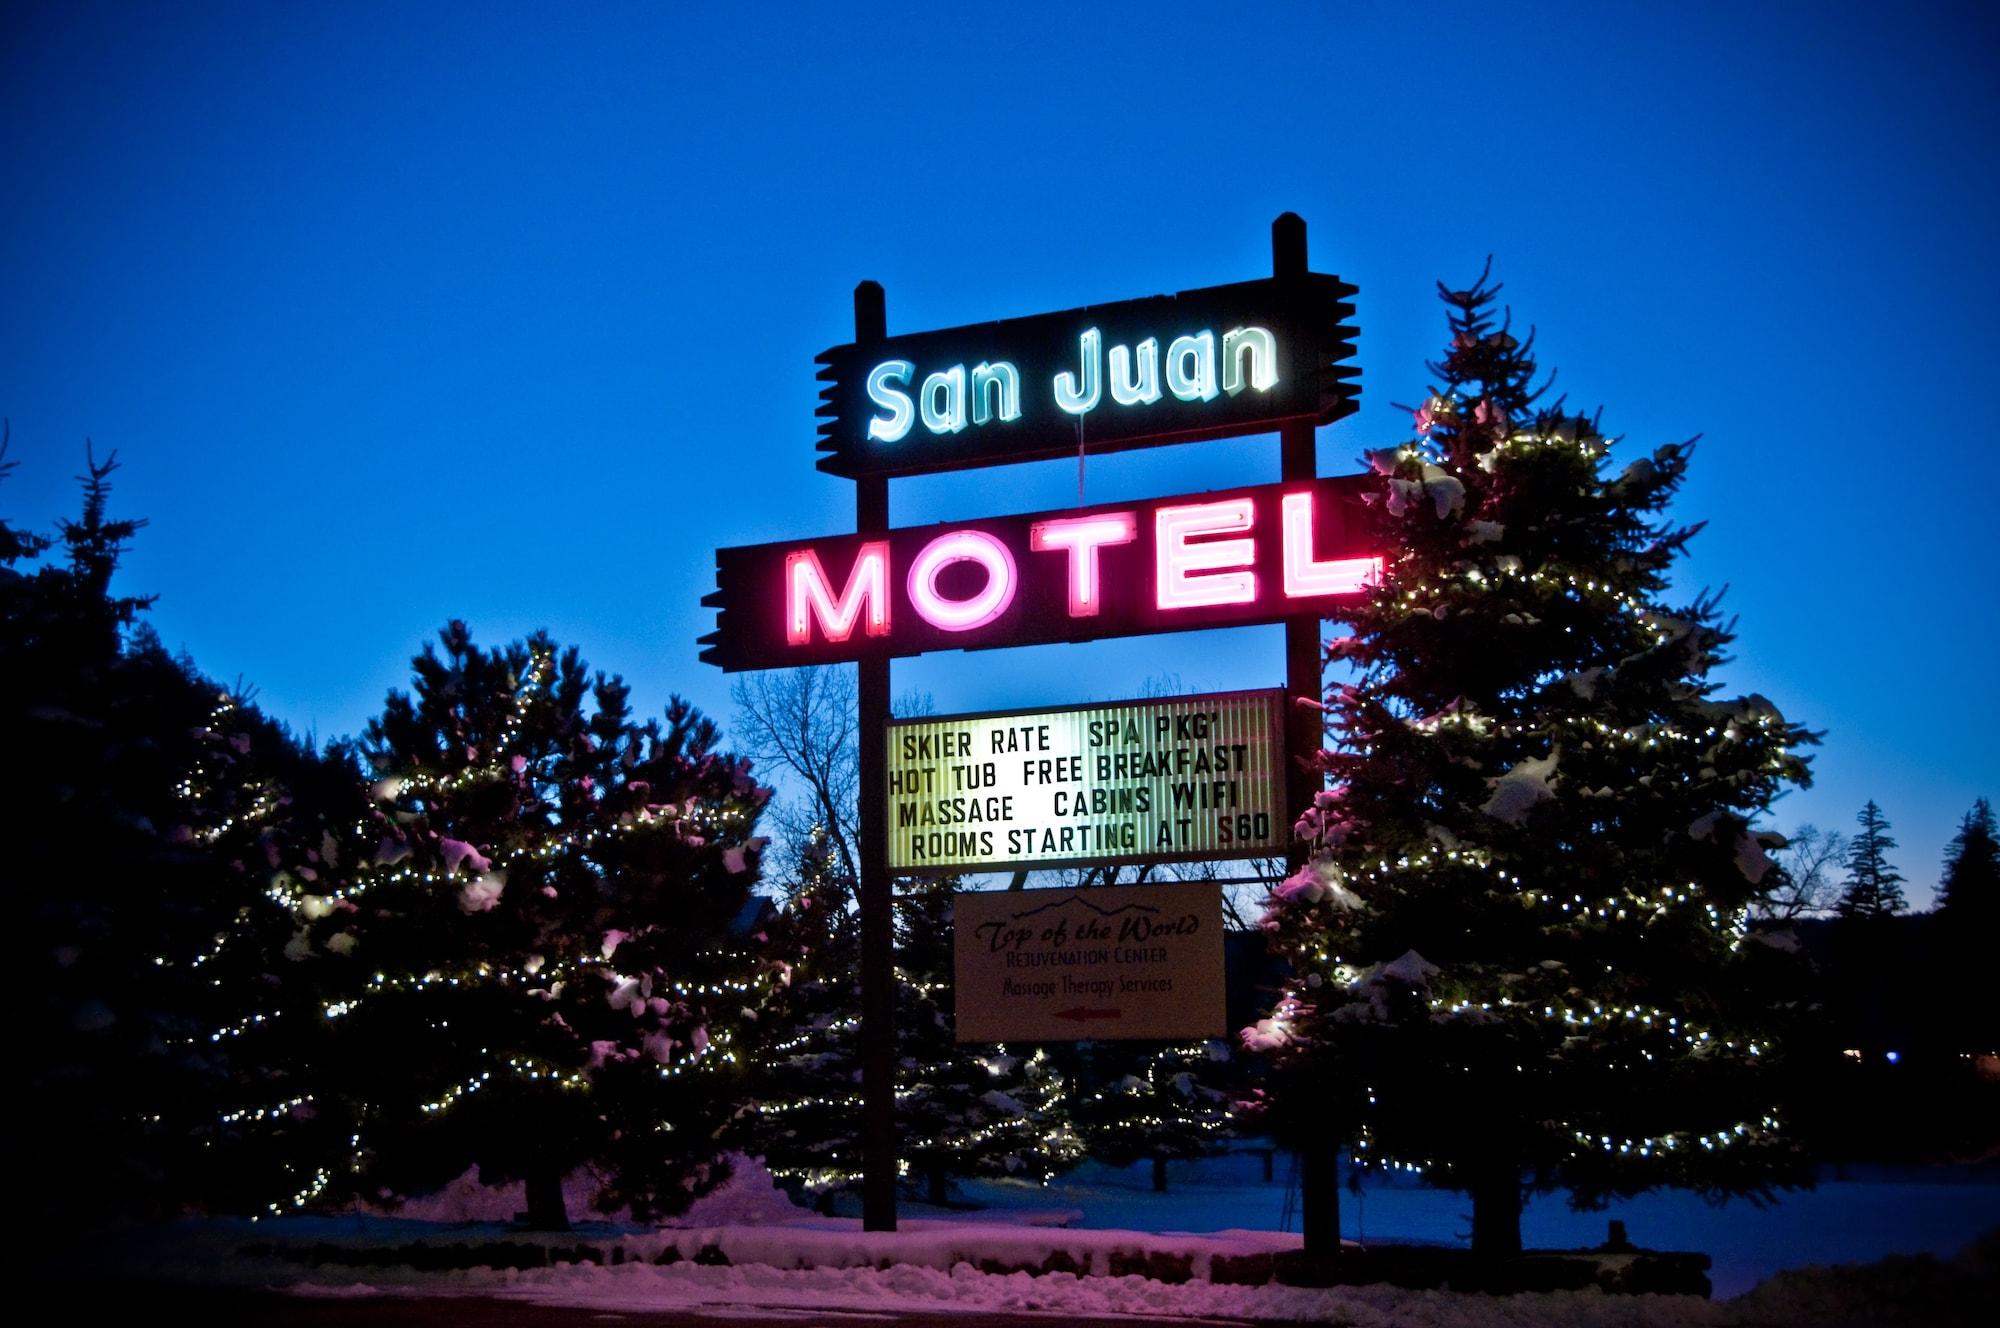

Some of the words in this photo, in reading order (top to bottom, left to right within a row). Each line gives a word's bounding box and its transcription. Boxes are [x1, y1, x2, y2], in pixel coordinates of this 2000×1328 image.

[868, 360, 1021, 442] San
[1054, 326, 1280, 415] Juan
[785, 491, 1384, 646] MOTEL
[903, 732, 971, 760] SKIER
[991, 725, 1050, 754] RATE
[1090, 718, 1140, 747] SPA
[890, 767, 935, 795] HOT
[952, 762, 996, 790] TUB
[1023, 756, 1082, 785] FREE
[1097, 744, 1246, 781] BREAKFAST
[899, 796, 1013, 827] MASSAGE
[1054, 786, 1150, 817] CABINS
[1172, 780, 1237, 810] WIFI
[911, 831, 994, 860] ROOMS
[1007, 822, 1135, 854] STARTING
[1156, 818, 1192, 847] AT
[975, 921, 1032, 952] Top
[1040, 917, 1068, 947] of
[1075, 918, 1111, 940] the
[1117, 914, 1200, 943] World
[1002, 977, 1056, 999] Massage
[1062, 974, 1114, 998] Therapy
[1119, 975, 1173, 993] Services
